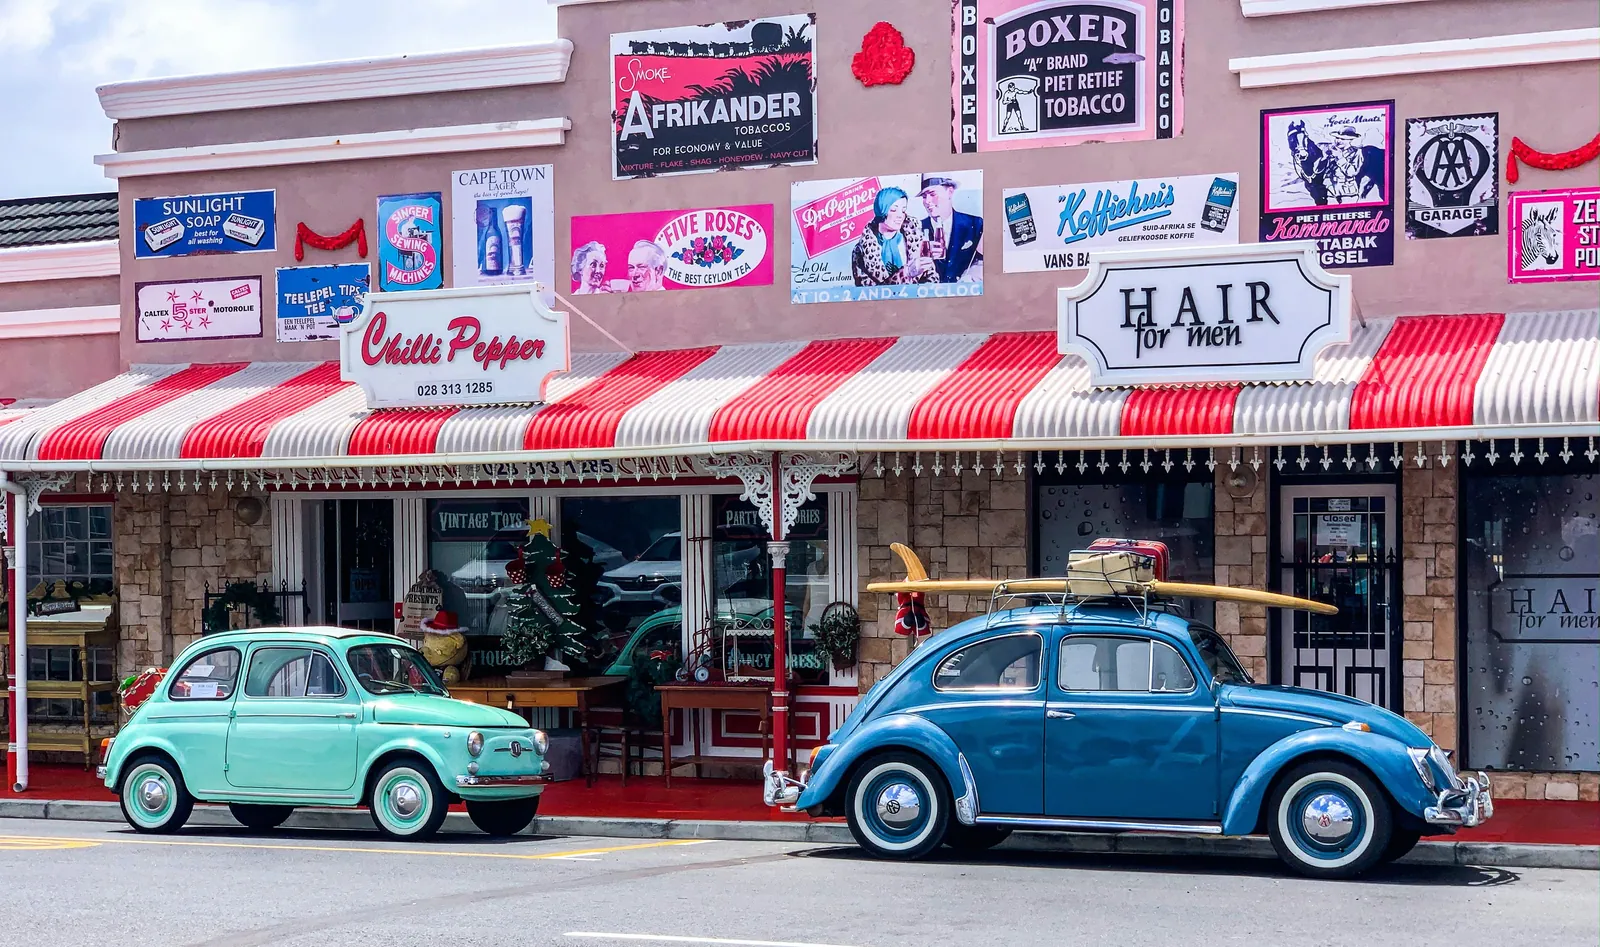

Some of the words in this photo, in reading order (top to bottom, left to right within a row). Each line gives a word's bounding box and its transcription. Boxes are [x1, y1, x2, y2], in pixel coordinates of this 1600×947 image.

[1005, 14, 1127, 60] BOXER
[1046, 54, 1088, 71] BRAND
[1159, 0, 1171, 130] OBACCO
[619, 58, 671, 92] SMOKE
[962, 5, 977, 144] BOXER
[1044, 74, 1074, 92] PIET
[1078, 70, 1124, 90] RETIEF
[1044, 92, 1126, 118] TOBACCO
[620, 90, 801, 141] AFRIKANDER
[734, 122, 791, 136] TOBACCOS
[653, 147, 671, 156] FOR
[674, 142, 720, 155] ECONOMY
[724, 142, 730, 150] &
[735, 138, 762, 149] VALUE
[620, 162, 654, 172] MIXTURE
[660, 160, 683, 168] FLAKE
[690, 158, 712, 166] SHAG
[719, 154, 763, 164] HONEYDEW
[770, 151, 790, 160] NAVY
[792, 150, 809, 158] CUT
[459, 171, 498, 186] CAPE
[500, 167, 546, 182] TOWN
[488, 182, 516, 191] LAGER
[163, 196, 244, 216] SUNLIGHT
[824, 187, 876, 218] Pepper
[1572, 198, 1600, 224] ZE
[186, 216, 221, 228] SOAP
[230, 214, 258, 228] SUNLIGHT
[392, 206, 429, 224] SINGER
[1296, 215, 1320, 223] PIET
[1322, 210, 1371, 221] RETIEFSE
[1420, 208, 1482, 222] GARAGE
[840, 222, 856, 241] 5¢
[1142, 223, 1185, 232] SUID-AFRIKA
[1187, 222, 1196, 230] SE
[1266, 210, 1390, 240] Kommando
[198, 236, 224, 245] washing
[390, 234, 428, 253] SEWING
[1118, 234, 1168, 242] GELIEFKOOSDE
[1170, 232, 1194, 240] KOFFIE
[1044, 253, 1074, 270] VANS
[1574, 247, 1600, 267] PO
[388, 260, 435, 284] MACHINES
[668, 266, 682, 282] THE
[684, 274, 702, 284] BEST
[704, 270, 732, 284] CEYLON
[735, 262, 752, 277] TEA
[811, 262, 828, 272] Old
[821, 272, 852, 282] Custom
[284, 286, 336, 305] TEELEPEL
[338, 284, 360, 296] TIPS
[792, 292, 808, 304] AT
[858, 288, 892, 300] AND
[898, 286, 908, 298] 4
[144, 310, 169, 318] CALTEX
[172, 302, 188, 322] 5
[189, 307, 206, 316] STER
[214, 304, 254, 314] MOTOROLIE
[304, 302, 326, 315] TEE
[1119, 280, 1280, 329] HAIR
[284, 318, 294, 326] EEN
[361, 312, 442, 366] Chilli
[448, 316, 546, 371] Pepper
[1134, 312, 1170, 359] for
[1186, 324, 1242, 348] men
[417, 385, 438, 396] 028
[441, 384, 462, 396] 313
[466, 382, 493, 394] 1285
[439, 512, 489, 531] VINTAGE
[490, 511, 522, 531] TOYS
[726, 510, 758, 526] PARTY
[1517, 604, 1546, 634] for
